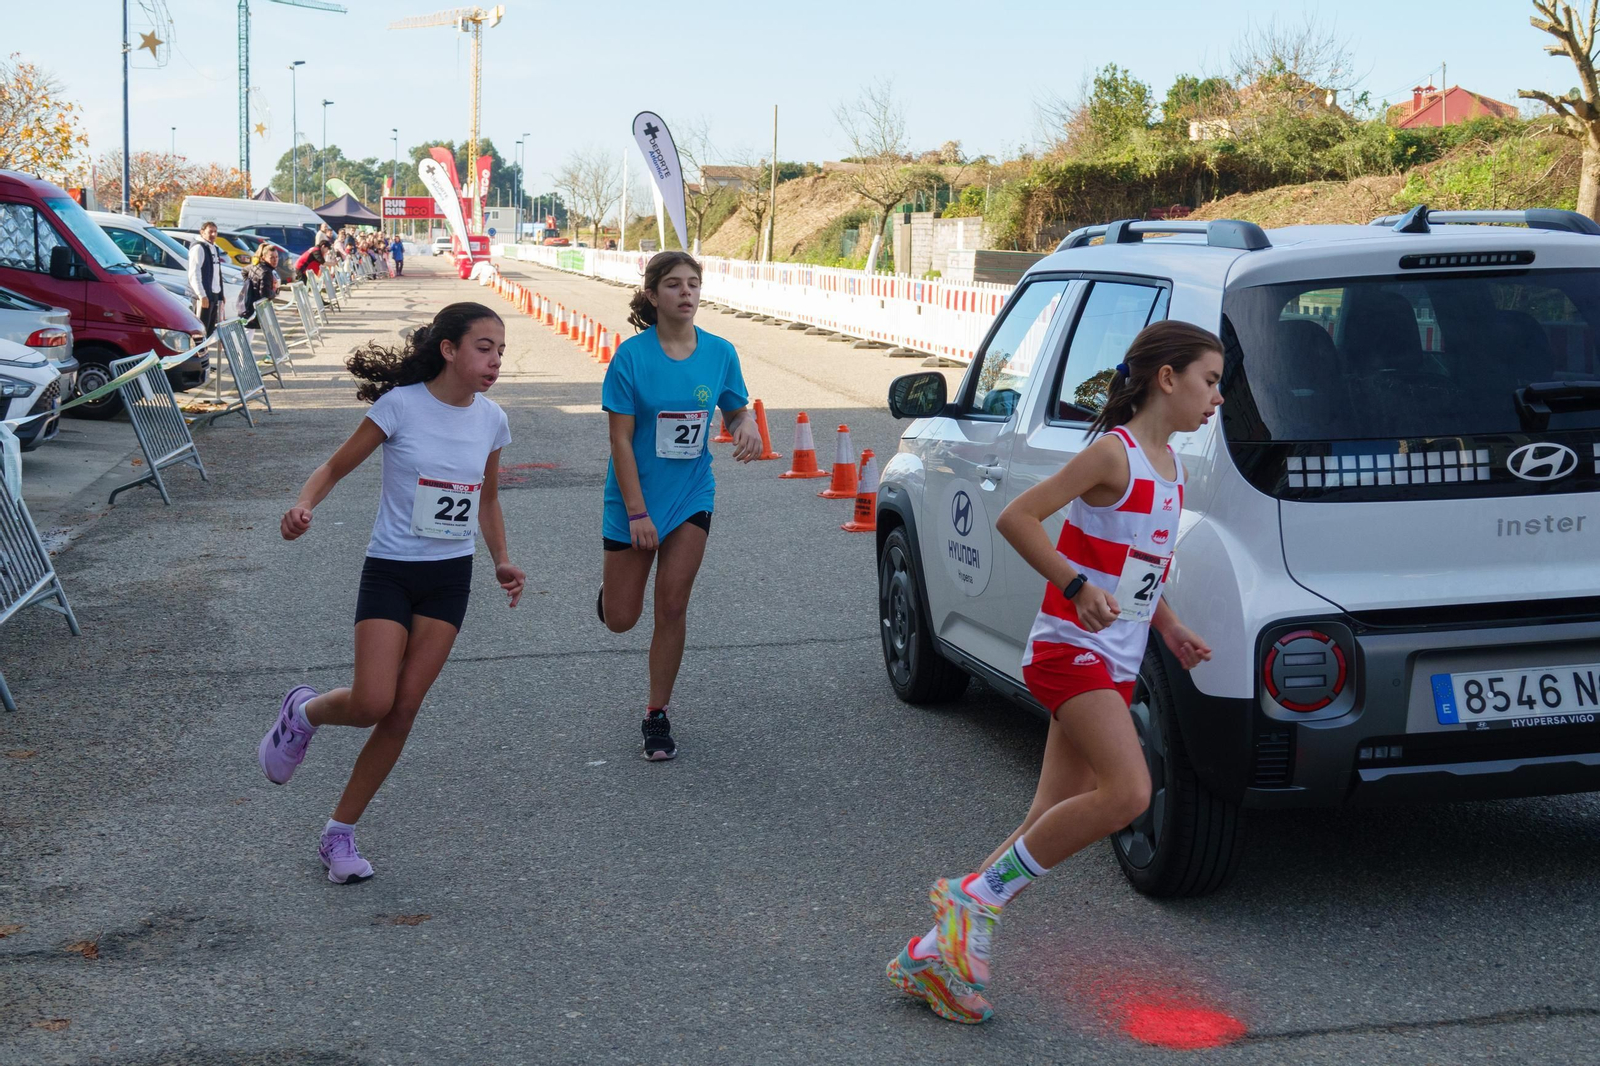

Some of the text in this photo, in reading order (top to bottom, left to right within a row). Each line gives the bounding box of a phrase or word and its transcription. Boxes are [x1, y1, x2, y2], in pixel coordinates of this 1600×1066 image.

[649, 138, 671, 178] DEPORTE
[384, 199, 406, 208] RUN
[674, 423, 702, 445] 27
[434, 496, 472, 522] 22
[1497, 515, 1587, 537] inster
[948, 539, 980, 569] HYUNDAI
[1464, 671, 1600, 714] 8546 N
[1442, 703, 1452, 714] E
[1511, 714, 1595, 728] HYUPERSA VIGO
